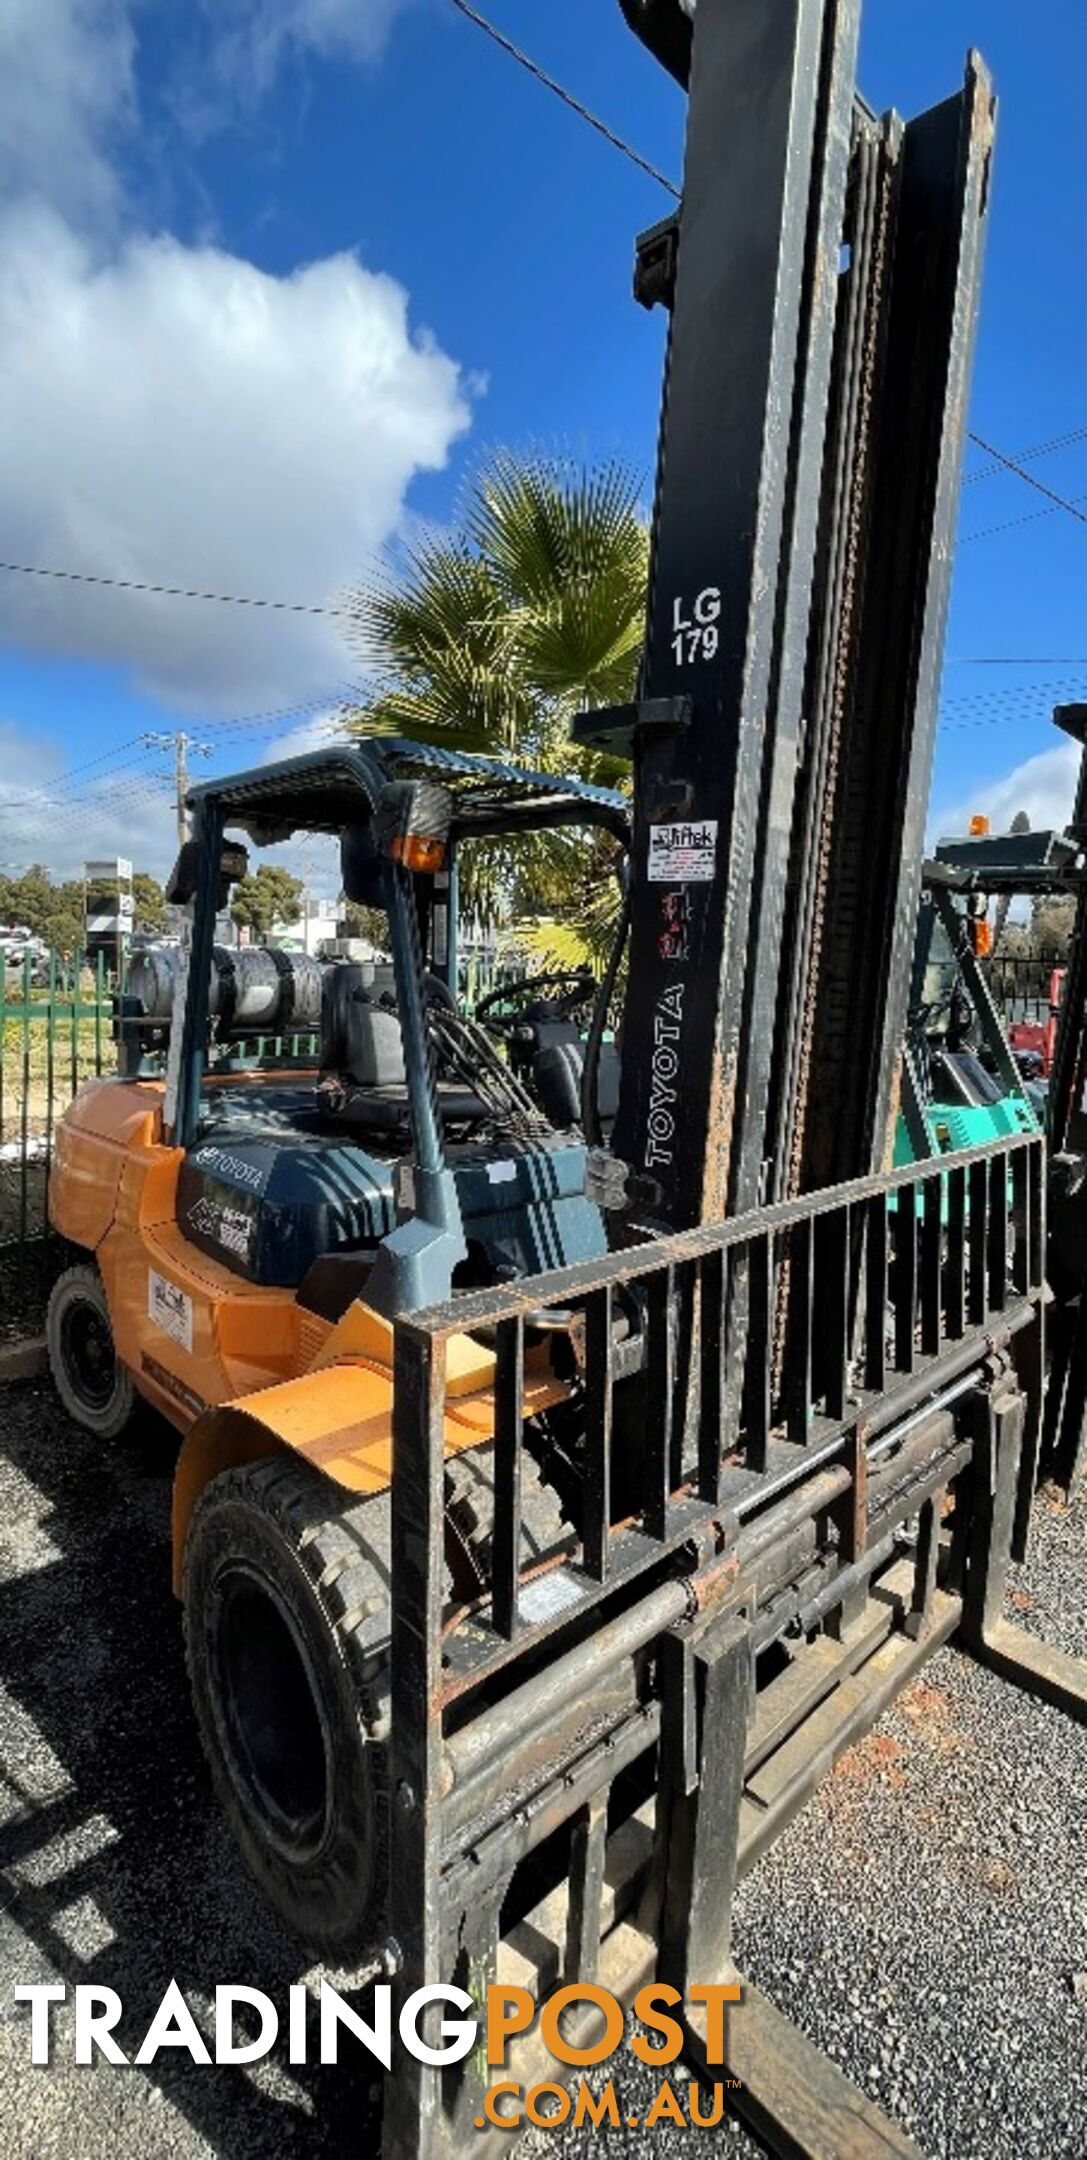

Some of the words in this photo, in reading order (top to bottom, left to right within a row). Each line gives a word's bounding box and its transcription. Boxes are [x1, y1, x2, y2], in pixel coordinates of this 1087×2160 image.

[673, 587, 721, 632] LG
[671, 625, 718, 666] 179
[644, 983, 685, 1168] TOYOTA
[213, 1153, 263, 1189] TOYOTA
